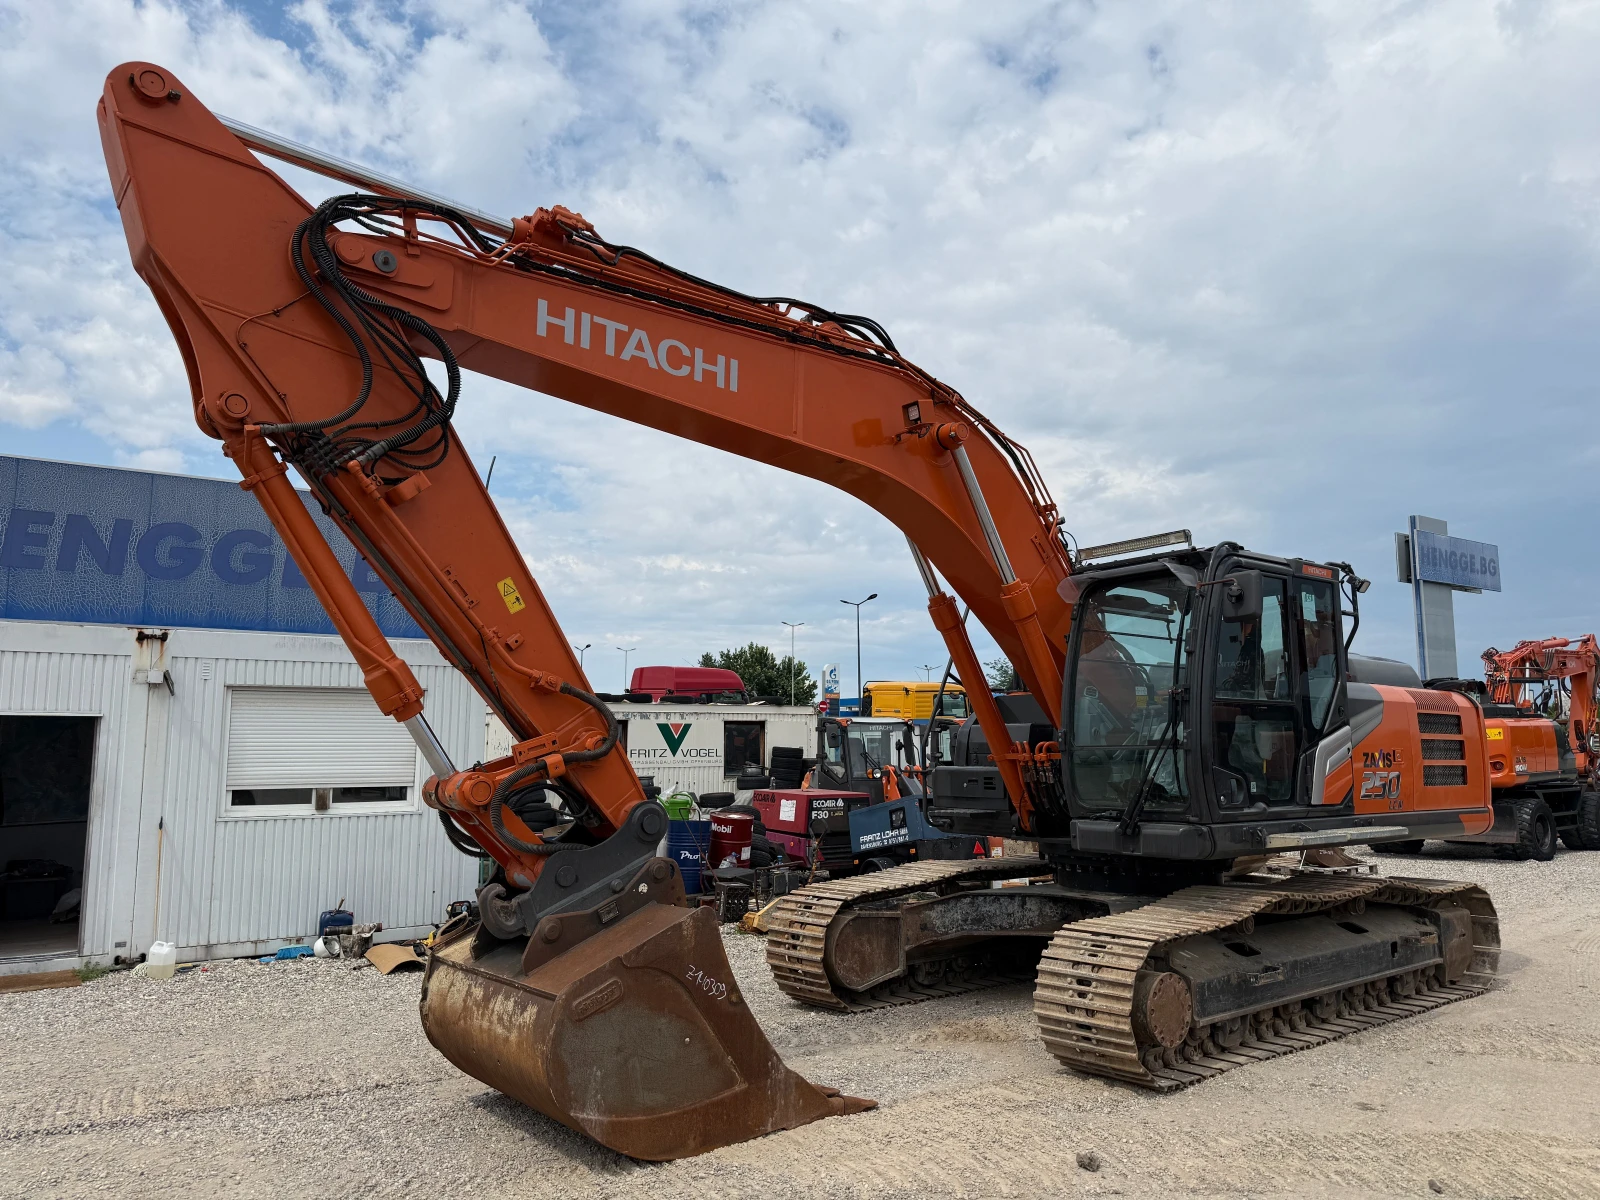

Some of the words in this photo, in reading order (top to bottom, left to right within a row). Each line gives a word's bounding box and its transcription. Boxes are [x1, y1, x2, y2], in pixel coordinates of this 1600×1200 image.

[536, 298, 739, 393] HITACHI
[1420, 545, 1497, 577] HENGGE.BG
[1307, 566, 1328, 576] HITACHI
[630, 749, 667, 758] FRITZ
[681, 749, 722, 758] VOGEL
[1363, 749, 1392, 768] ZAXIS
[1360, 771, 1401, 799] 250
[753, 793, 770, 803] ECOAIR
[812, 799, 836, 808] ECOAIR
[811, 810, 829, 820] F30
[711, 822, 732, 833] Mobil
[860, 832, 881, 843] FRANZ
[881, 829, 899, 839] LOHR
